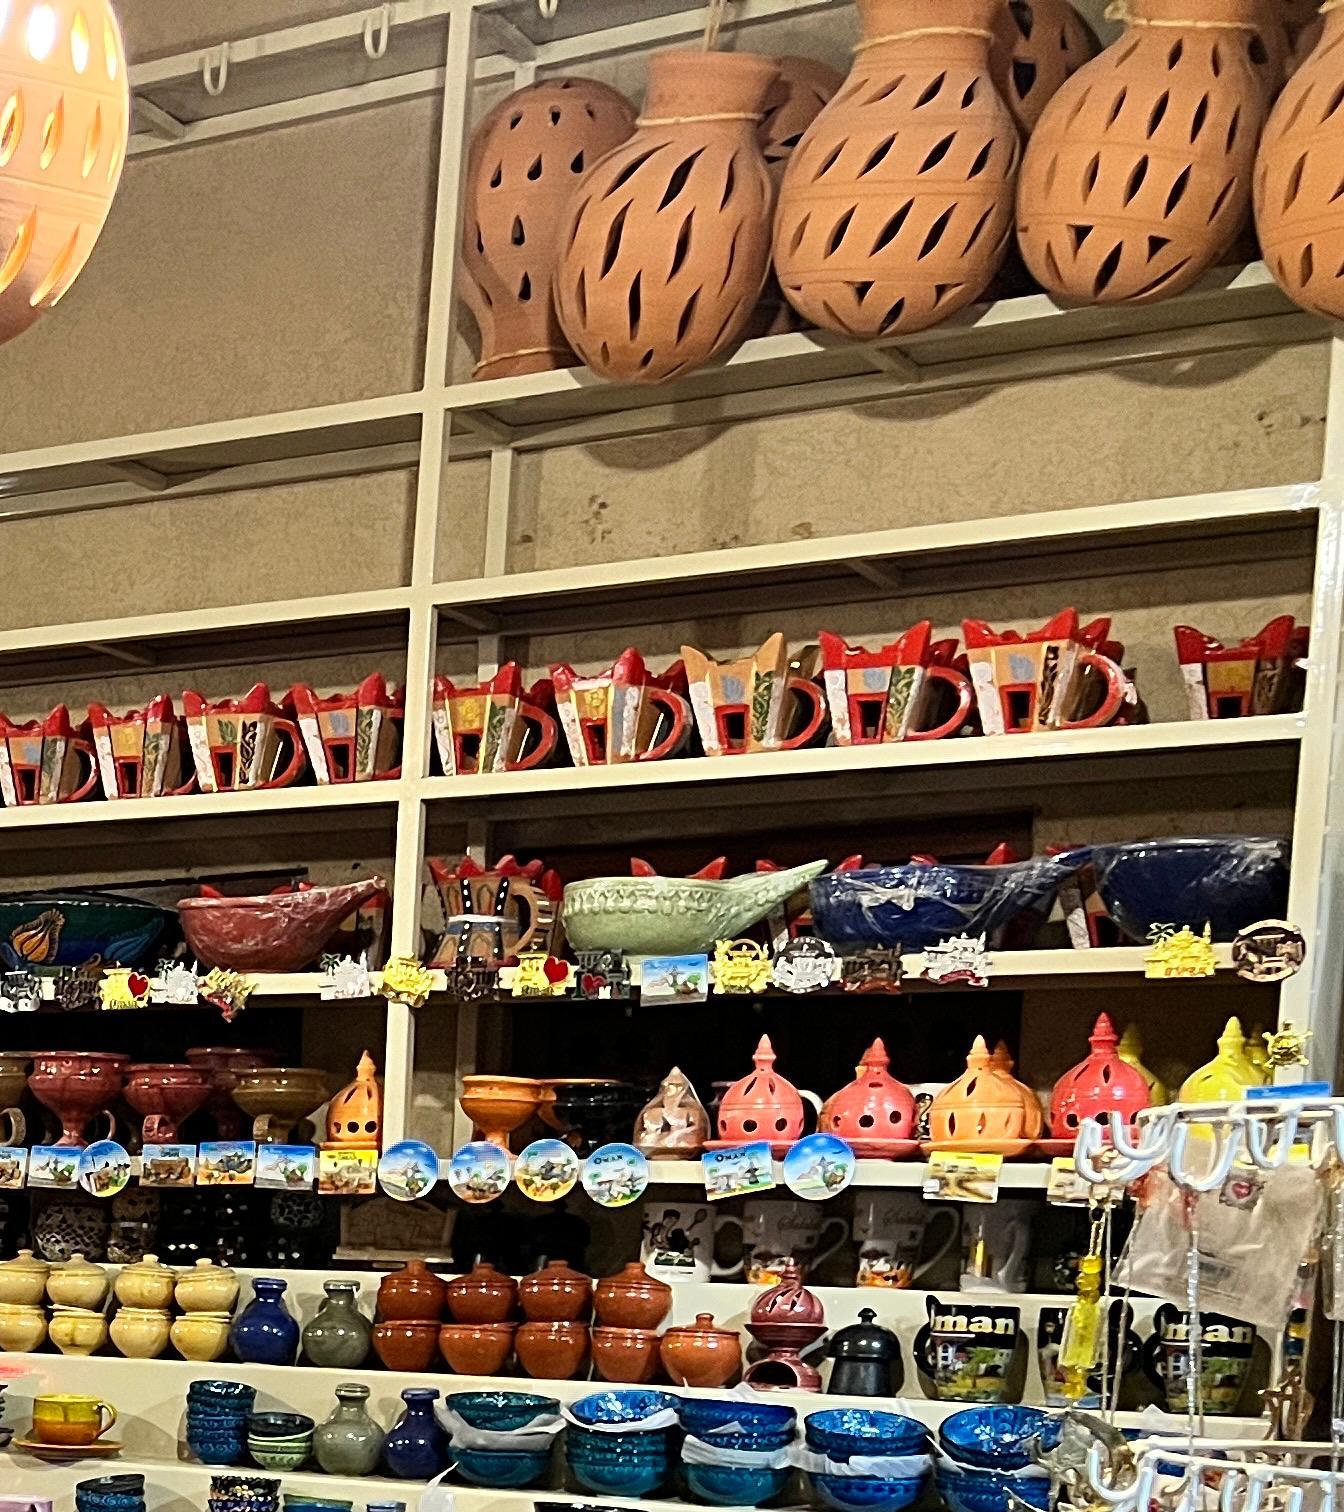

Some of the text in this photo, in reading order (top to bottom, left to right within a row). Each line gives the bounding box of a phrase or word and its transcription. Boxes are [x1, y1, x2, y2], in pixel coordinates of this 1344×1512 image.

[593, 1154, 624, 1165] OMAN
[714, 1151, 746, 1162] OMAN
[931, 1314, 1015, 1335] man
[1161, 1322, 1253, 1344] man
